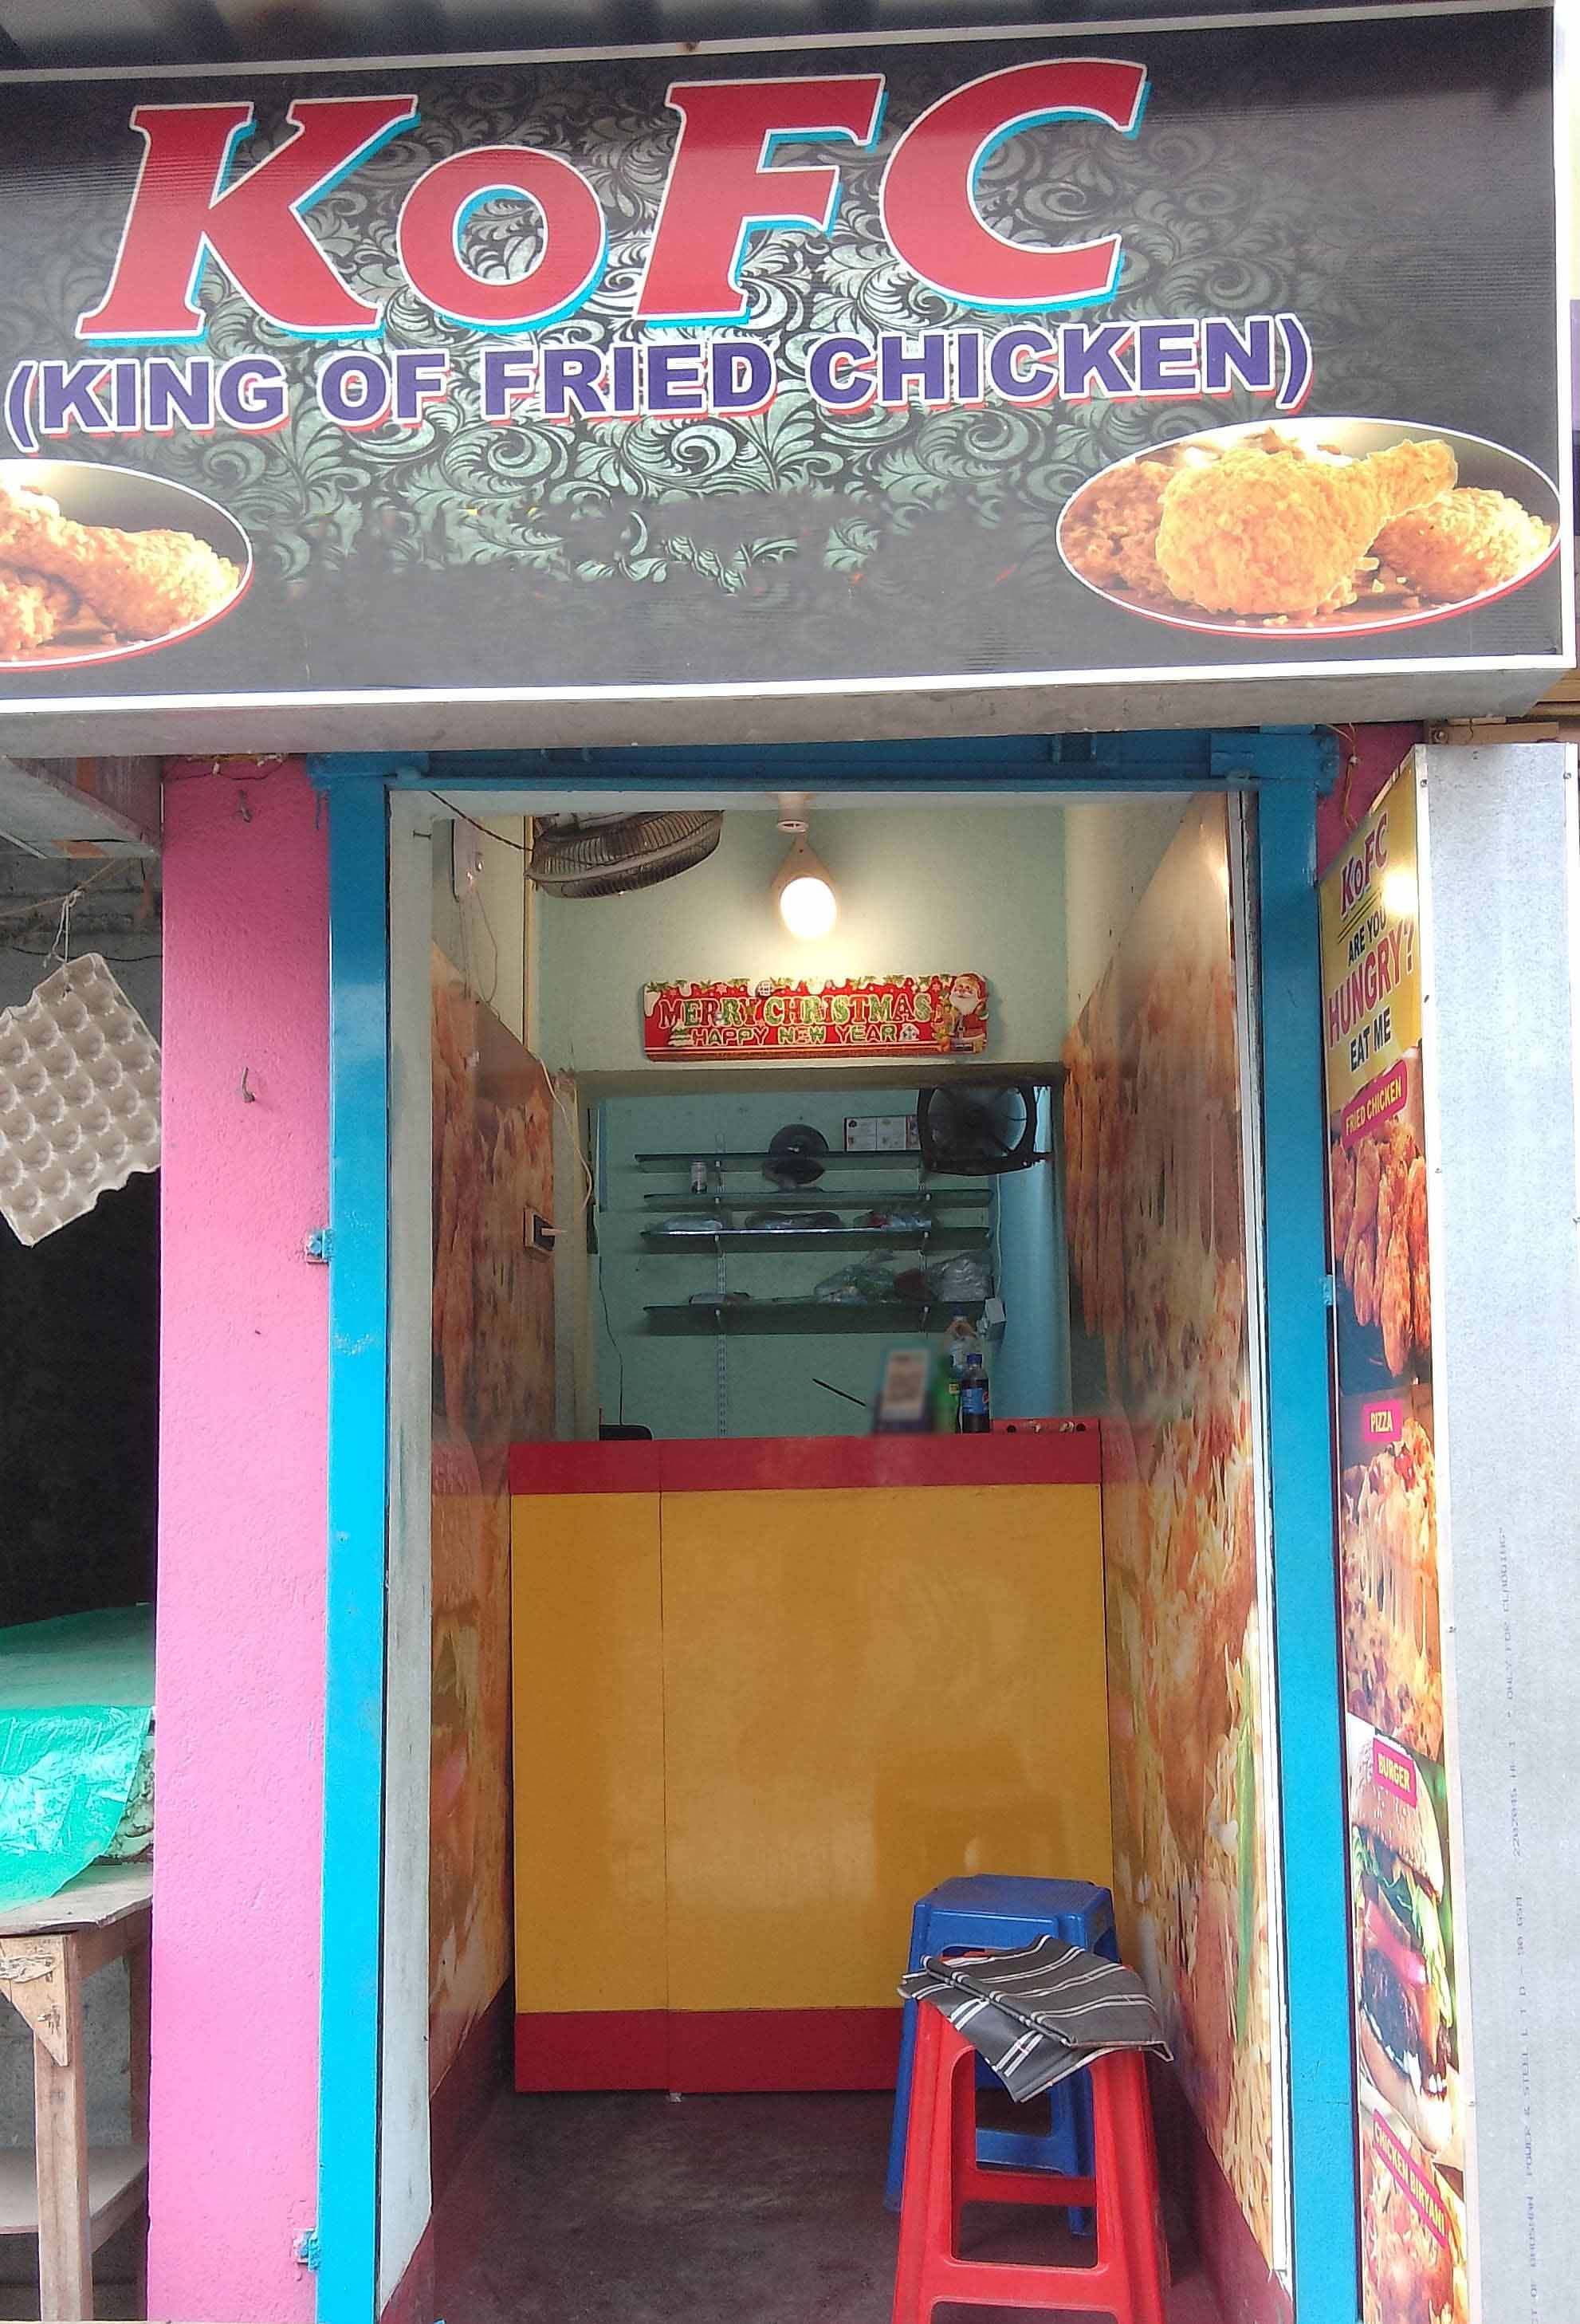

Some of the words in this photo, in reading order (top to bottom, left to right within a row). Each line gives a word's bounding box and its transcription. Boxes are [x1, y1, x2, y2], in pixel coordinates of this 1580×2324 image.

[4, 357, 290, 458] (KING
[319, 345, 450, 432] OF
[480, 336, 780, 424] FRIED
[807, 314, 1314, 415] CHICKEN)
[1348, 925, 1366, 966] ARE
[1366, 906, 1387, 943] YOU
[658, 997, 763, 1029] MERRY
[763, 993, 931, 1026] CHRISTMAS
[1327, 919, 1415, 1049] HUNGRY?
[690, 1027, 768, 1046] HAPPY
[777, 1026, 827, 1044] NEW
[835, 1024, 898, 1043] YEAR
[1350, 1025, 1371, 1073] EAT
[1373, 1006, 1392, 1053] ME
[1346, 1107, 1366, 1136] FRIED
[1366, 1076, 1402, 1122] CHICKEN
[1370, 1410, 1393, 1433] PIZZA
[1378, 1753, 1411, 1793] BURGER
